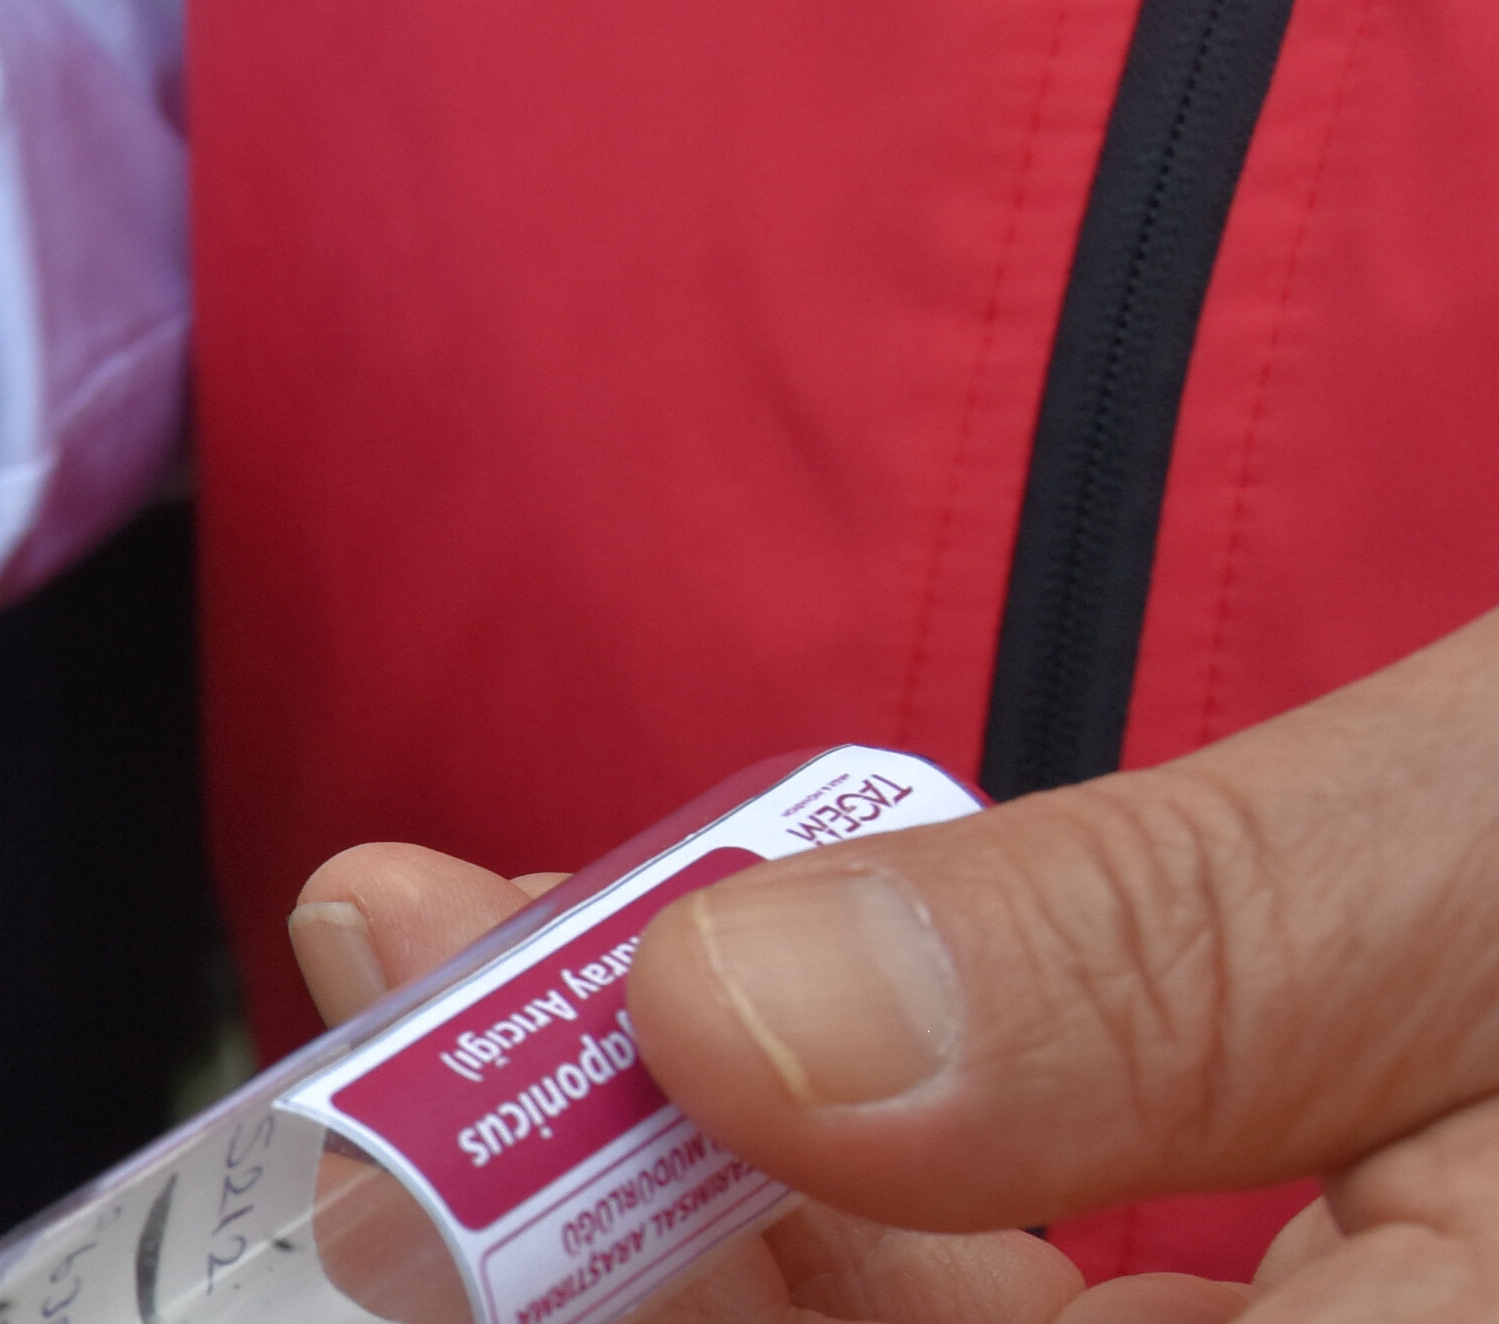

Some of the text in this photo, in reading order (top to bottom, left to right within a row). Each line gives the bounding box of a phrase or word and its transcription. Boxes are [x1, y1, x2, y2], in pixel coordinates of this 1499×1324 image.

[785, 774, 914, 847] TAGEM
[439, 989, 578, 1083] Arıcığı)
[562, 1131, 706, 1256] MÜDÜRLÜĞÜ
